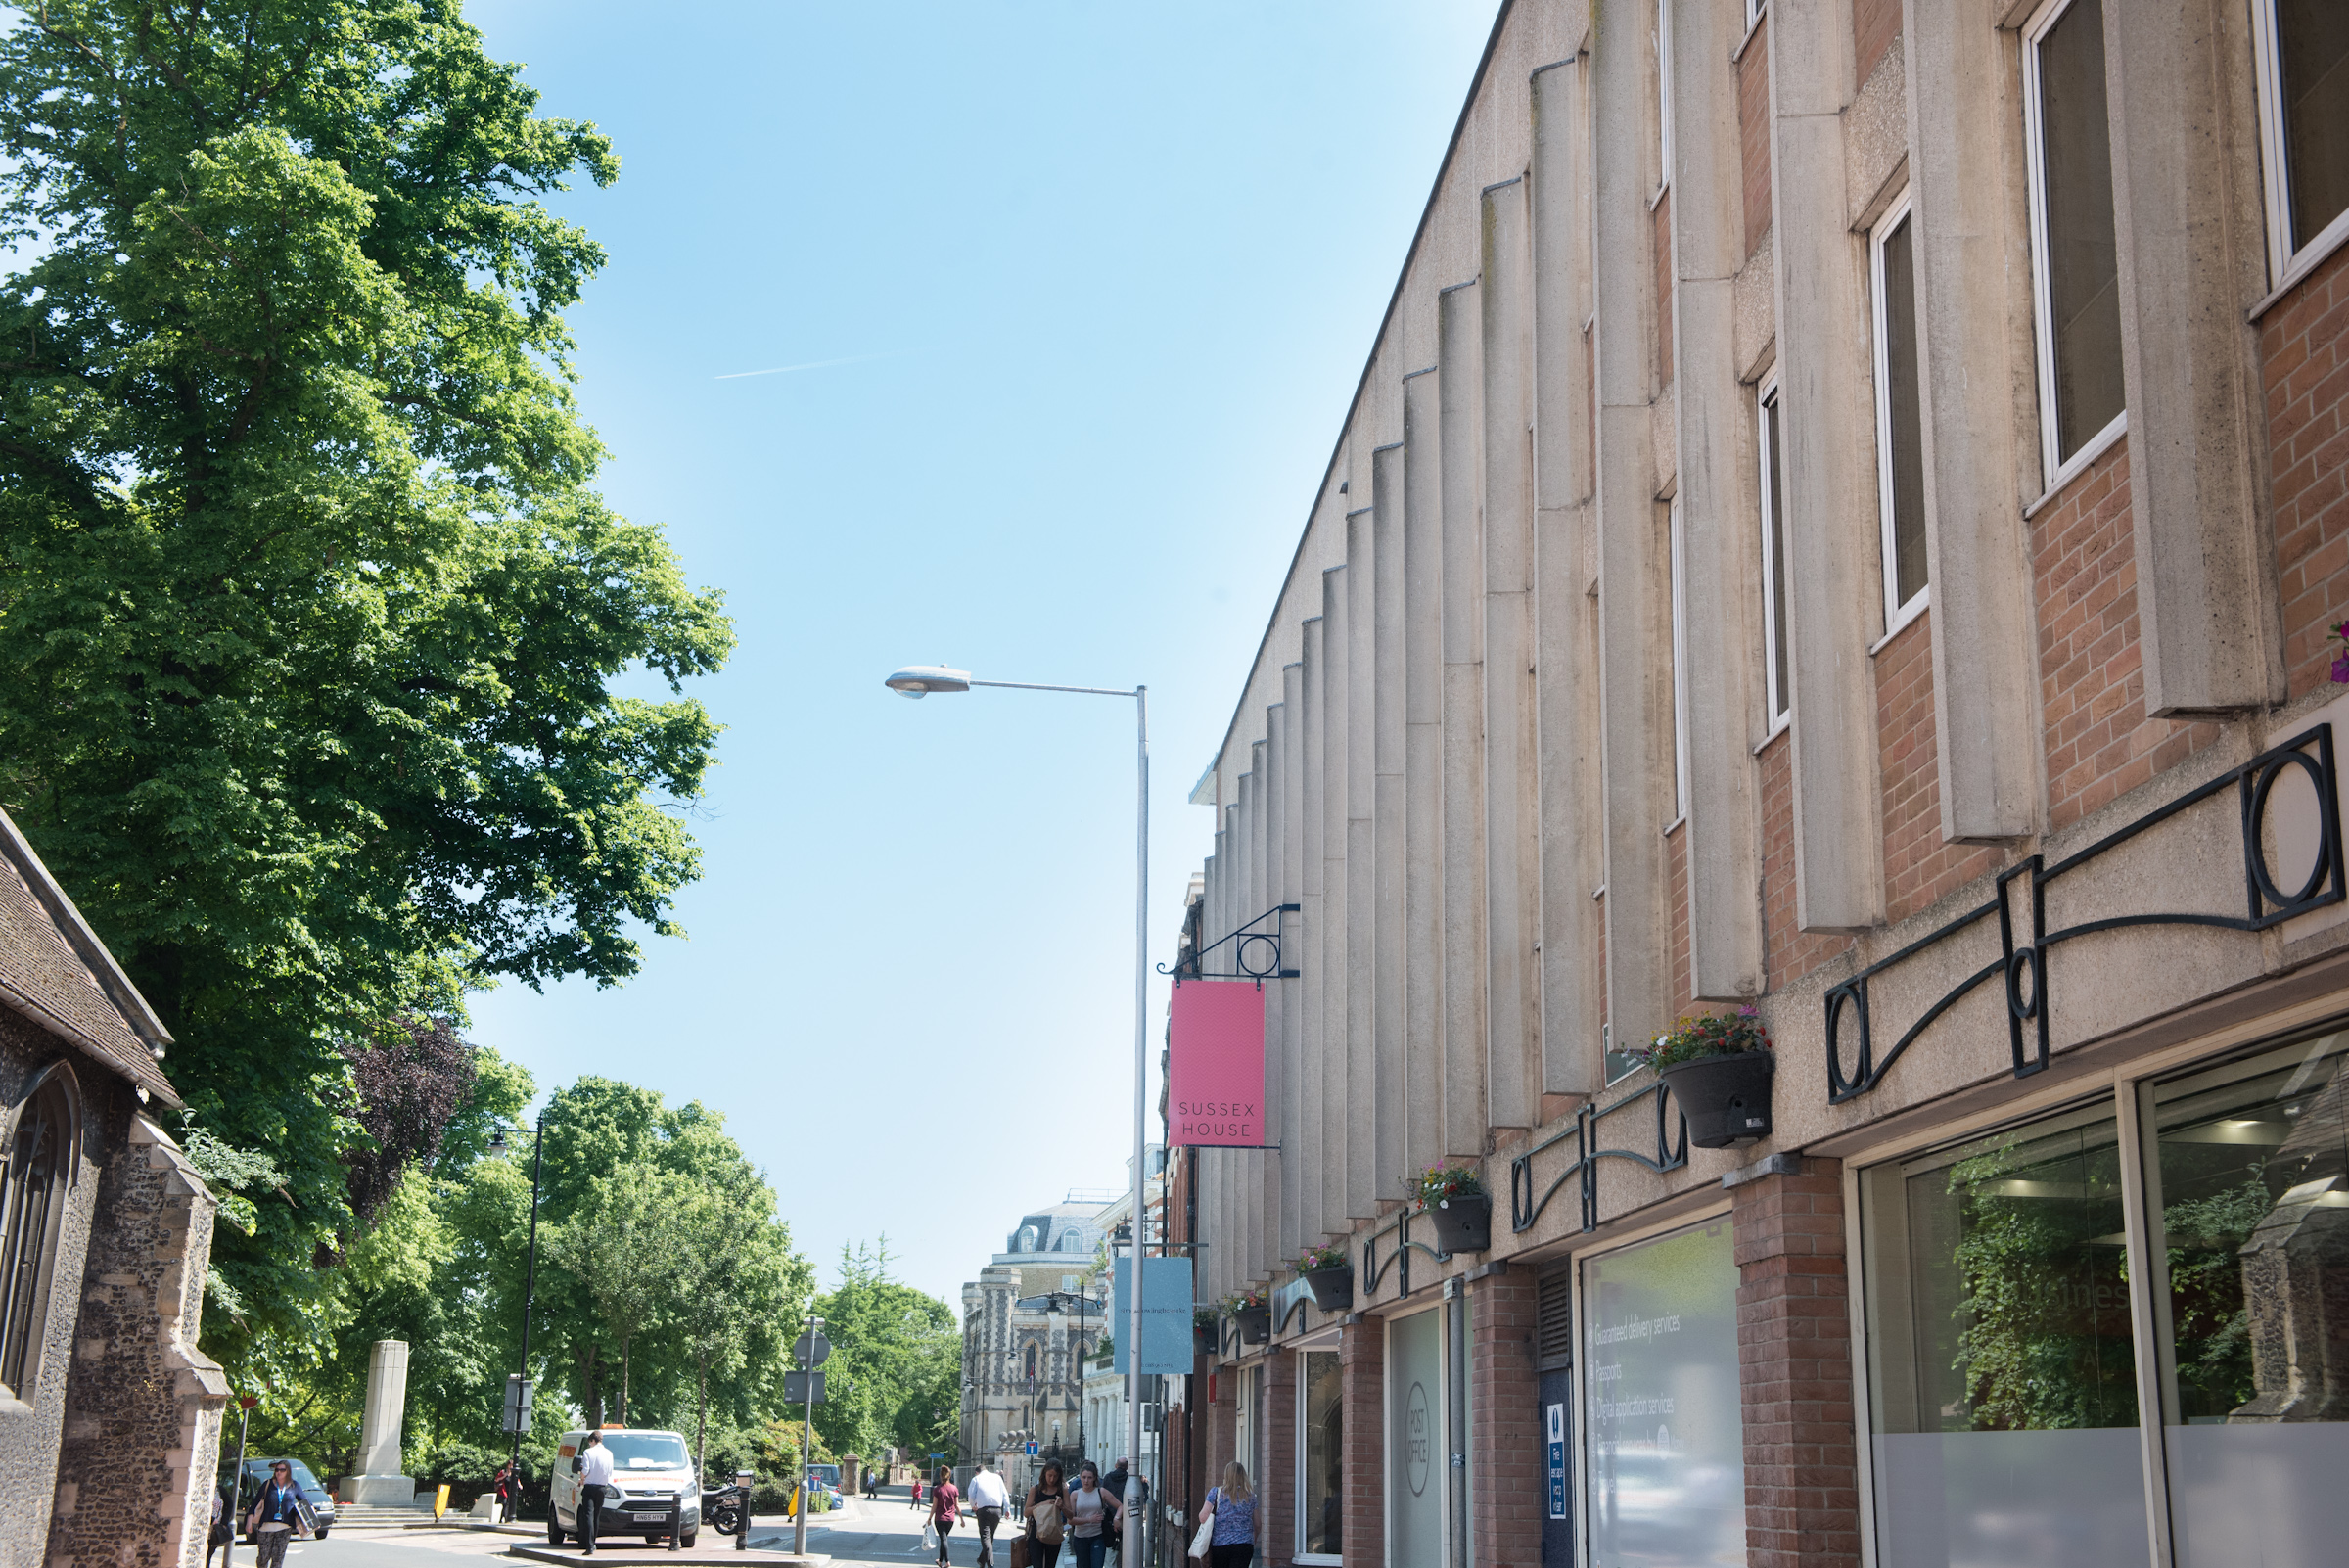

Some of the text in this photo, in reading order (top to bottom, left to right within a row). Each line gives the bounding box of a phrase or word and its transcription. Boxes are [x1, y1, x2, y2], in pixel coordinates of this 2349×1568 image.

[1178, 1102, 1255, 1117] SUSSEX
[1182, 1122, 1251, 1137] HOUSE
[1595, 1313, 1680, 1345] Guaranteed delivery services
[1595, 1360, 1622, 1388] Passports
[1410, 1409, 1424, 1434] POST
[1596, 1393, 1674, 1426] Digital application services
[1407, 1439, 1426, 1464] OFFICE
